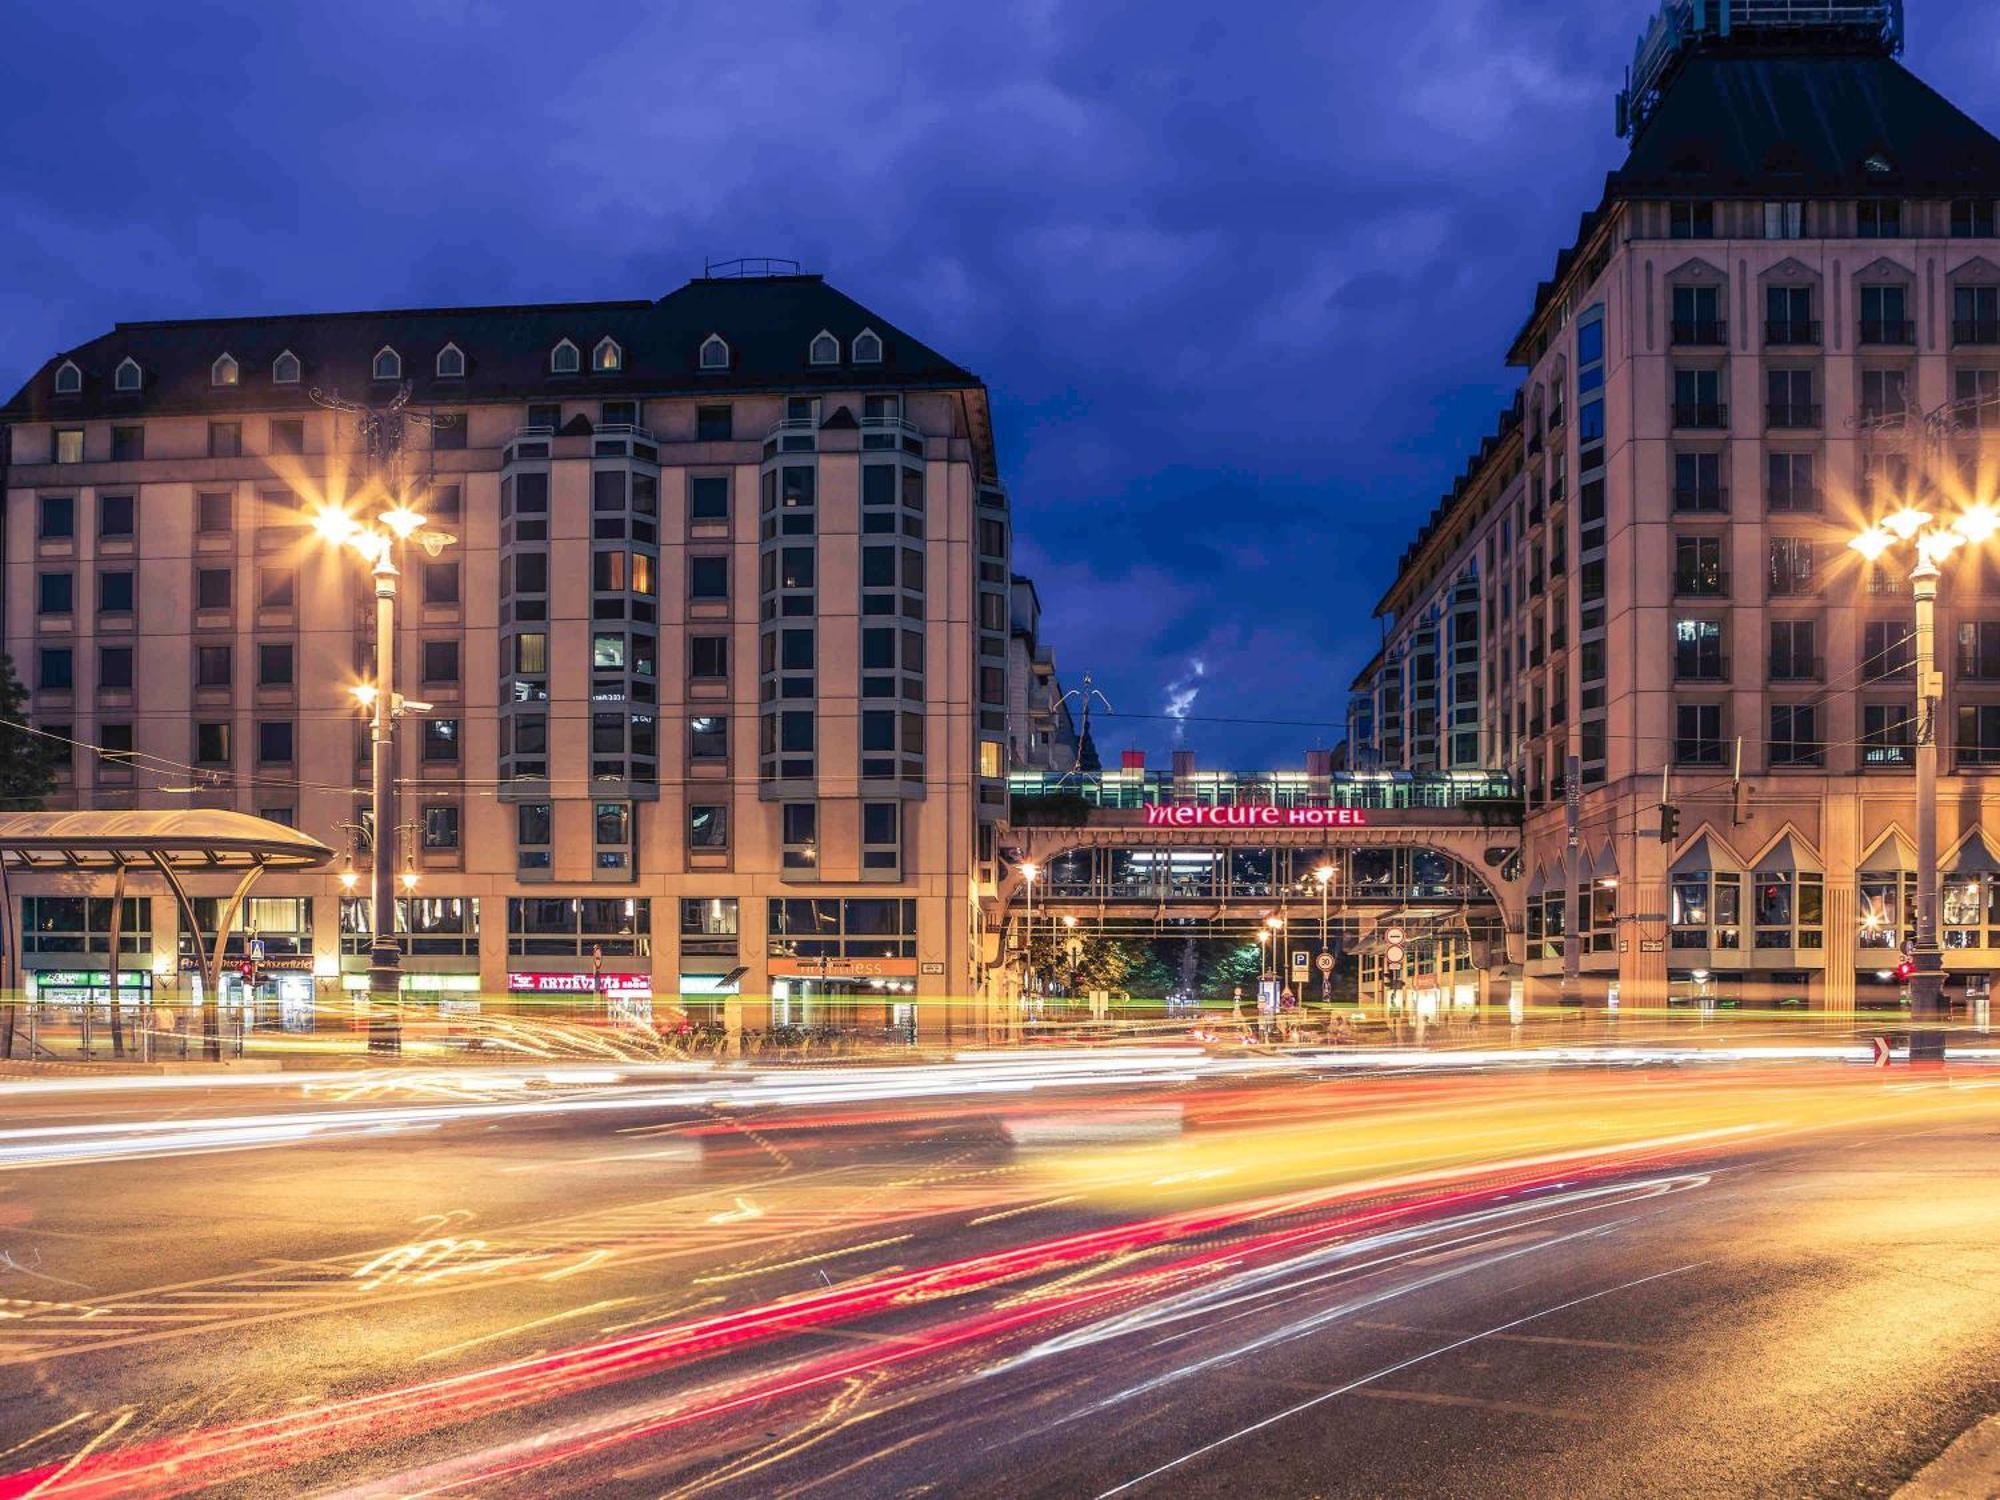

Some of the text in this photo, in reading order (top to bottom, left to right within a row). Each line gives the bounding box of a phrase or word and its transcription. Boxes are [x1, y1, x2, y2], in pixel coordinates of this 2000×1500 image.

[1289, 809, 1365, 824] HOTEL
[1297, 955, 1305, 965] P
[1321, 958, 1330, 966] 30
